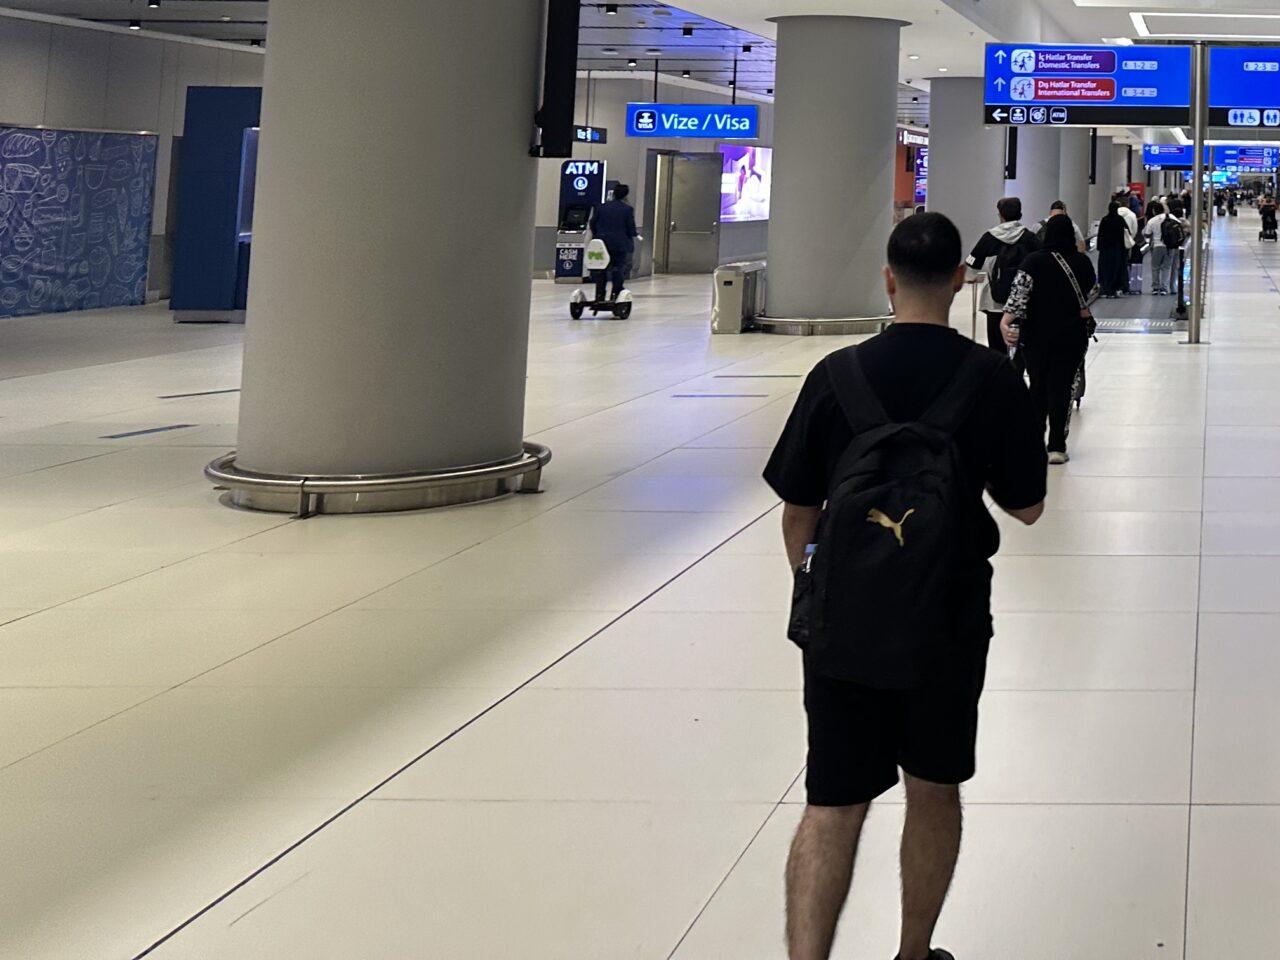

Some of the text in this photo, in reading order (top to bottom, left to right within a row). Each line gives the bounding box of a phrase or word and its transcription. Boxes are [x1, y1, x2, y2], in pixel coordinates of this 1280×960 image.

[1066, 53, 1092, 61] Transfer
[1038, 61, 1100, 69] Domestic Transfers
[661, 113, 750, 130] Vize / Visa
[565, 161, 599, 175] ATM
